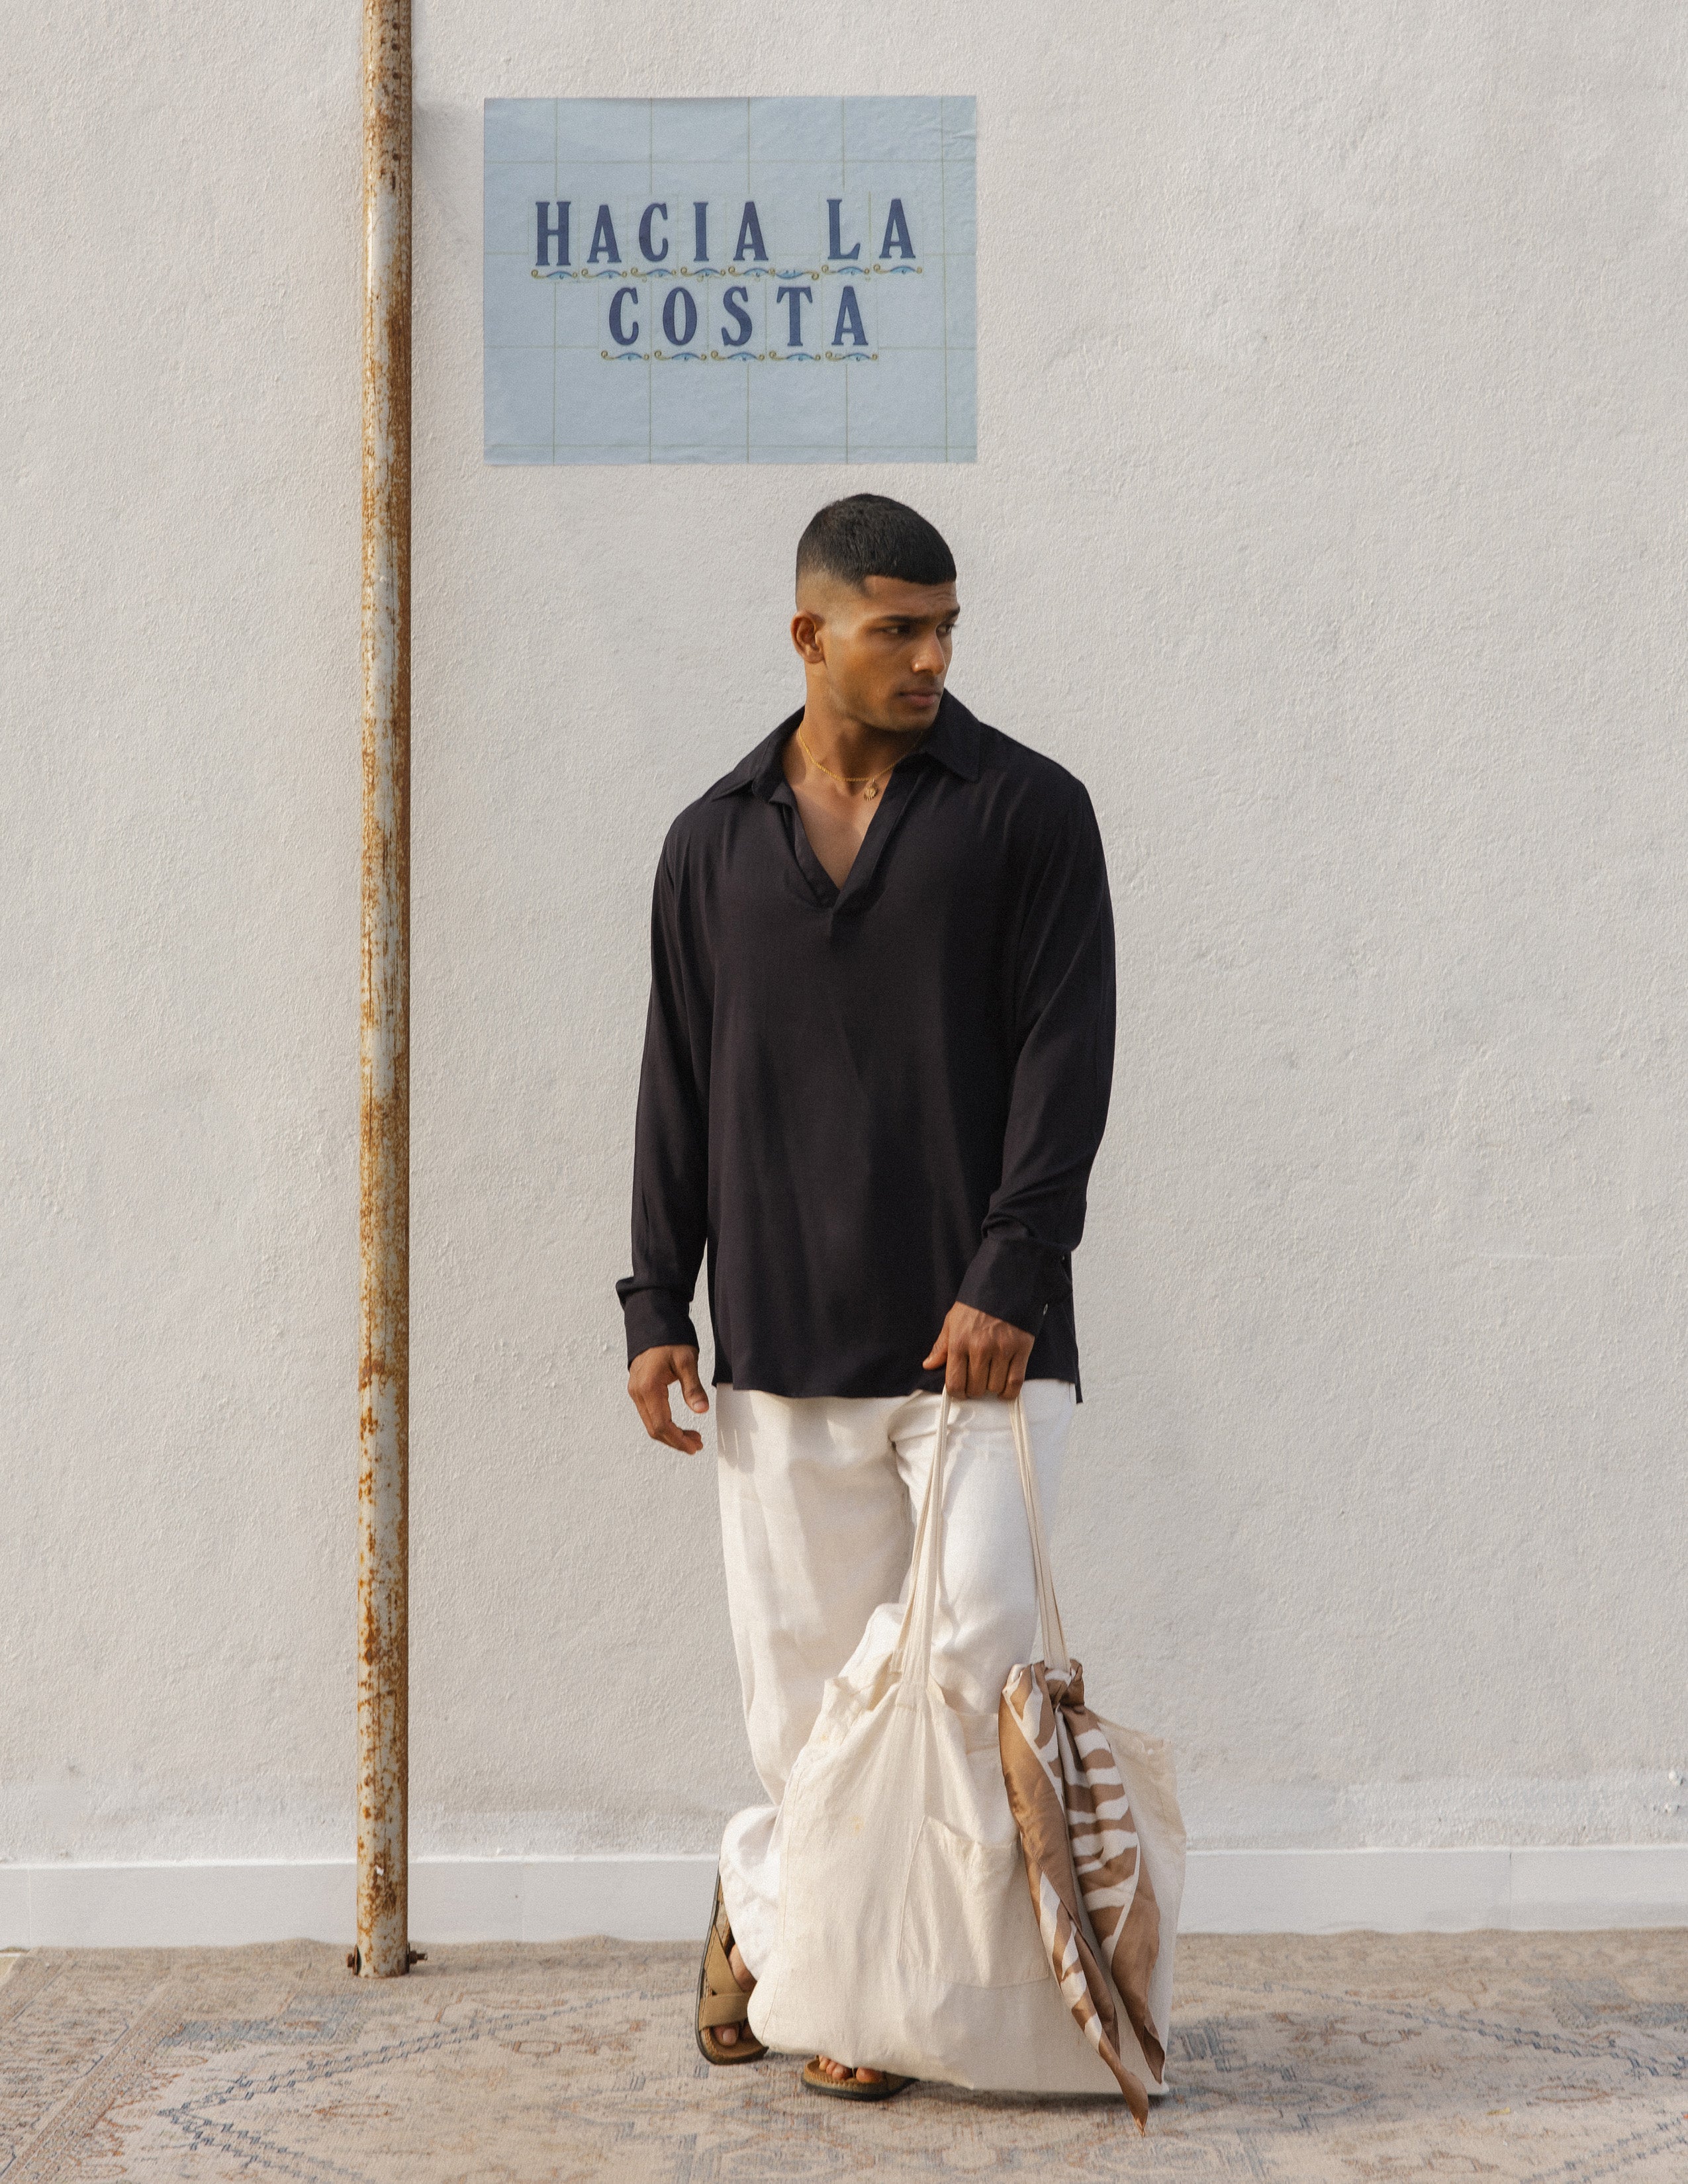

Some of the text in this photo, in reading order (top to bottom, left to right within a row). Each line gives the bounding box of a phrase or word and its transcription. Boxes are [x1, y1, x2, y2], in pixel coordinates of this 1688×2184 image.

[535, 198, 916, 267] HACIA LA
[608, 285, 870, 347] COSTA
